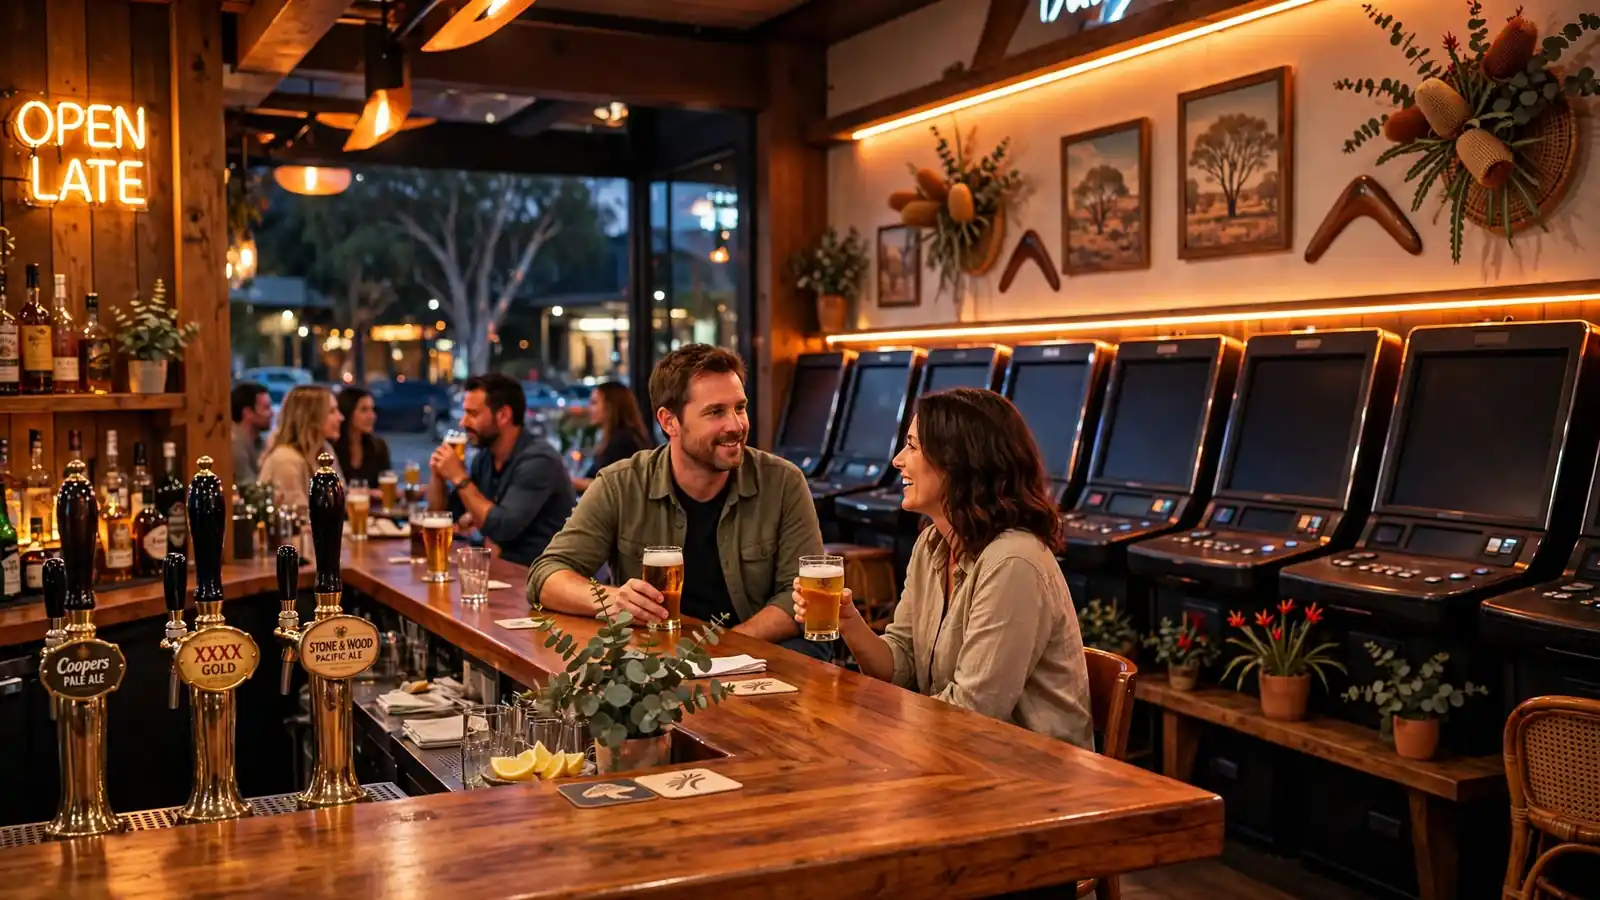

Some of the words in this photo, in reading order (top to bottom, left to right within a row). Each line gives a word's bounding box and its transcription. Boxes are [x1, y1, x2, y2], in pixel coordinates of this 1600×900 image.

[17, 100, 146, 149] OPEN
[32, 156, 145, 204] LATE
[194, 644, 243, 663] XXXX
[309, 641, 338, 653] STONE
[339, 640, 346, 651] &
[347, 638, 373, 649] WOOD
[316, 652, 345, 662] PACIFIC
[348, 651, 363, 660] ALE
[56, 657, 110, 675] Coopers
[201, 662, 236, 676] GOLD
[63, 675, 86, 687] PALE
[88, 673, 105, 685] ALE
